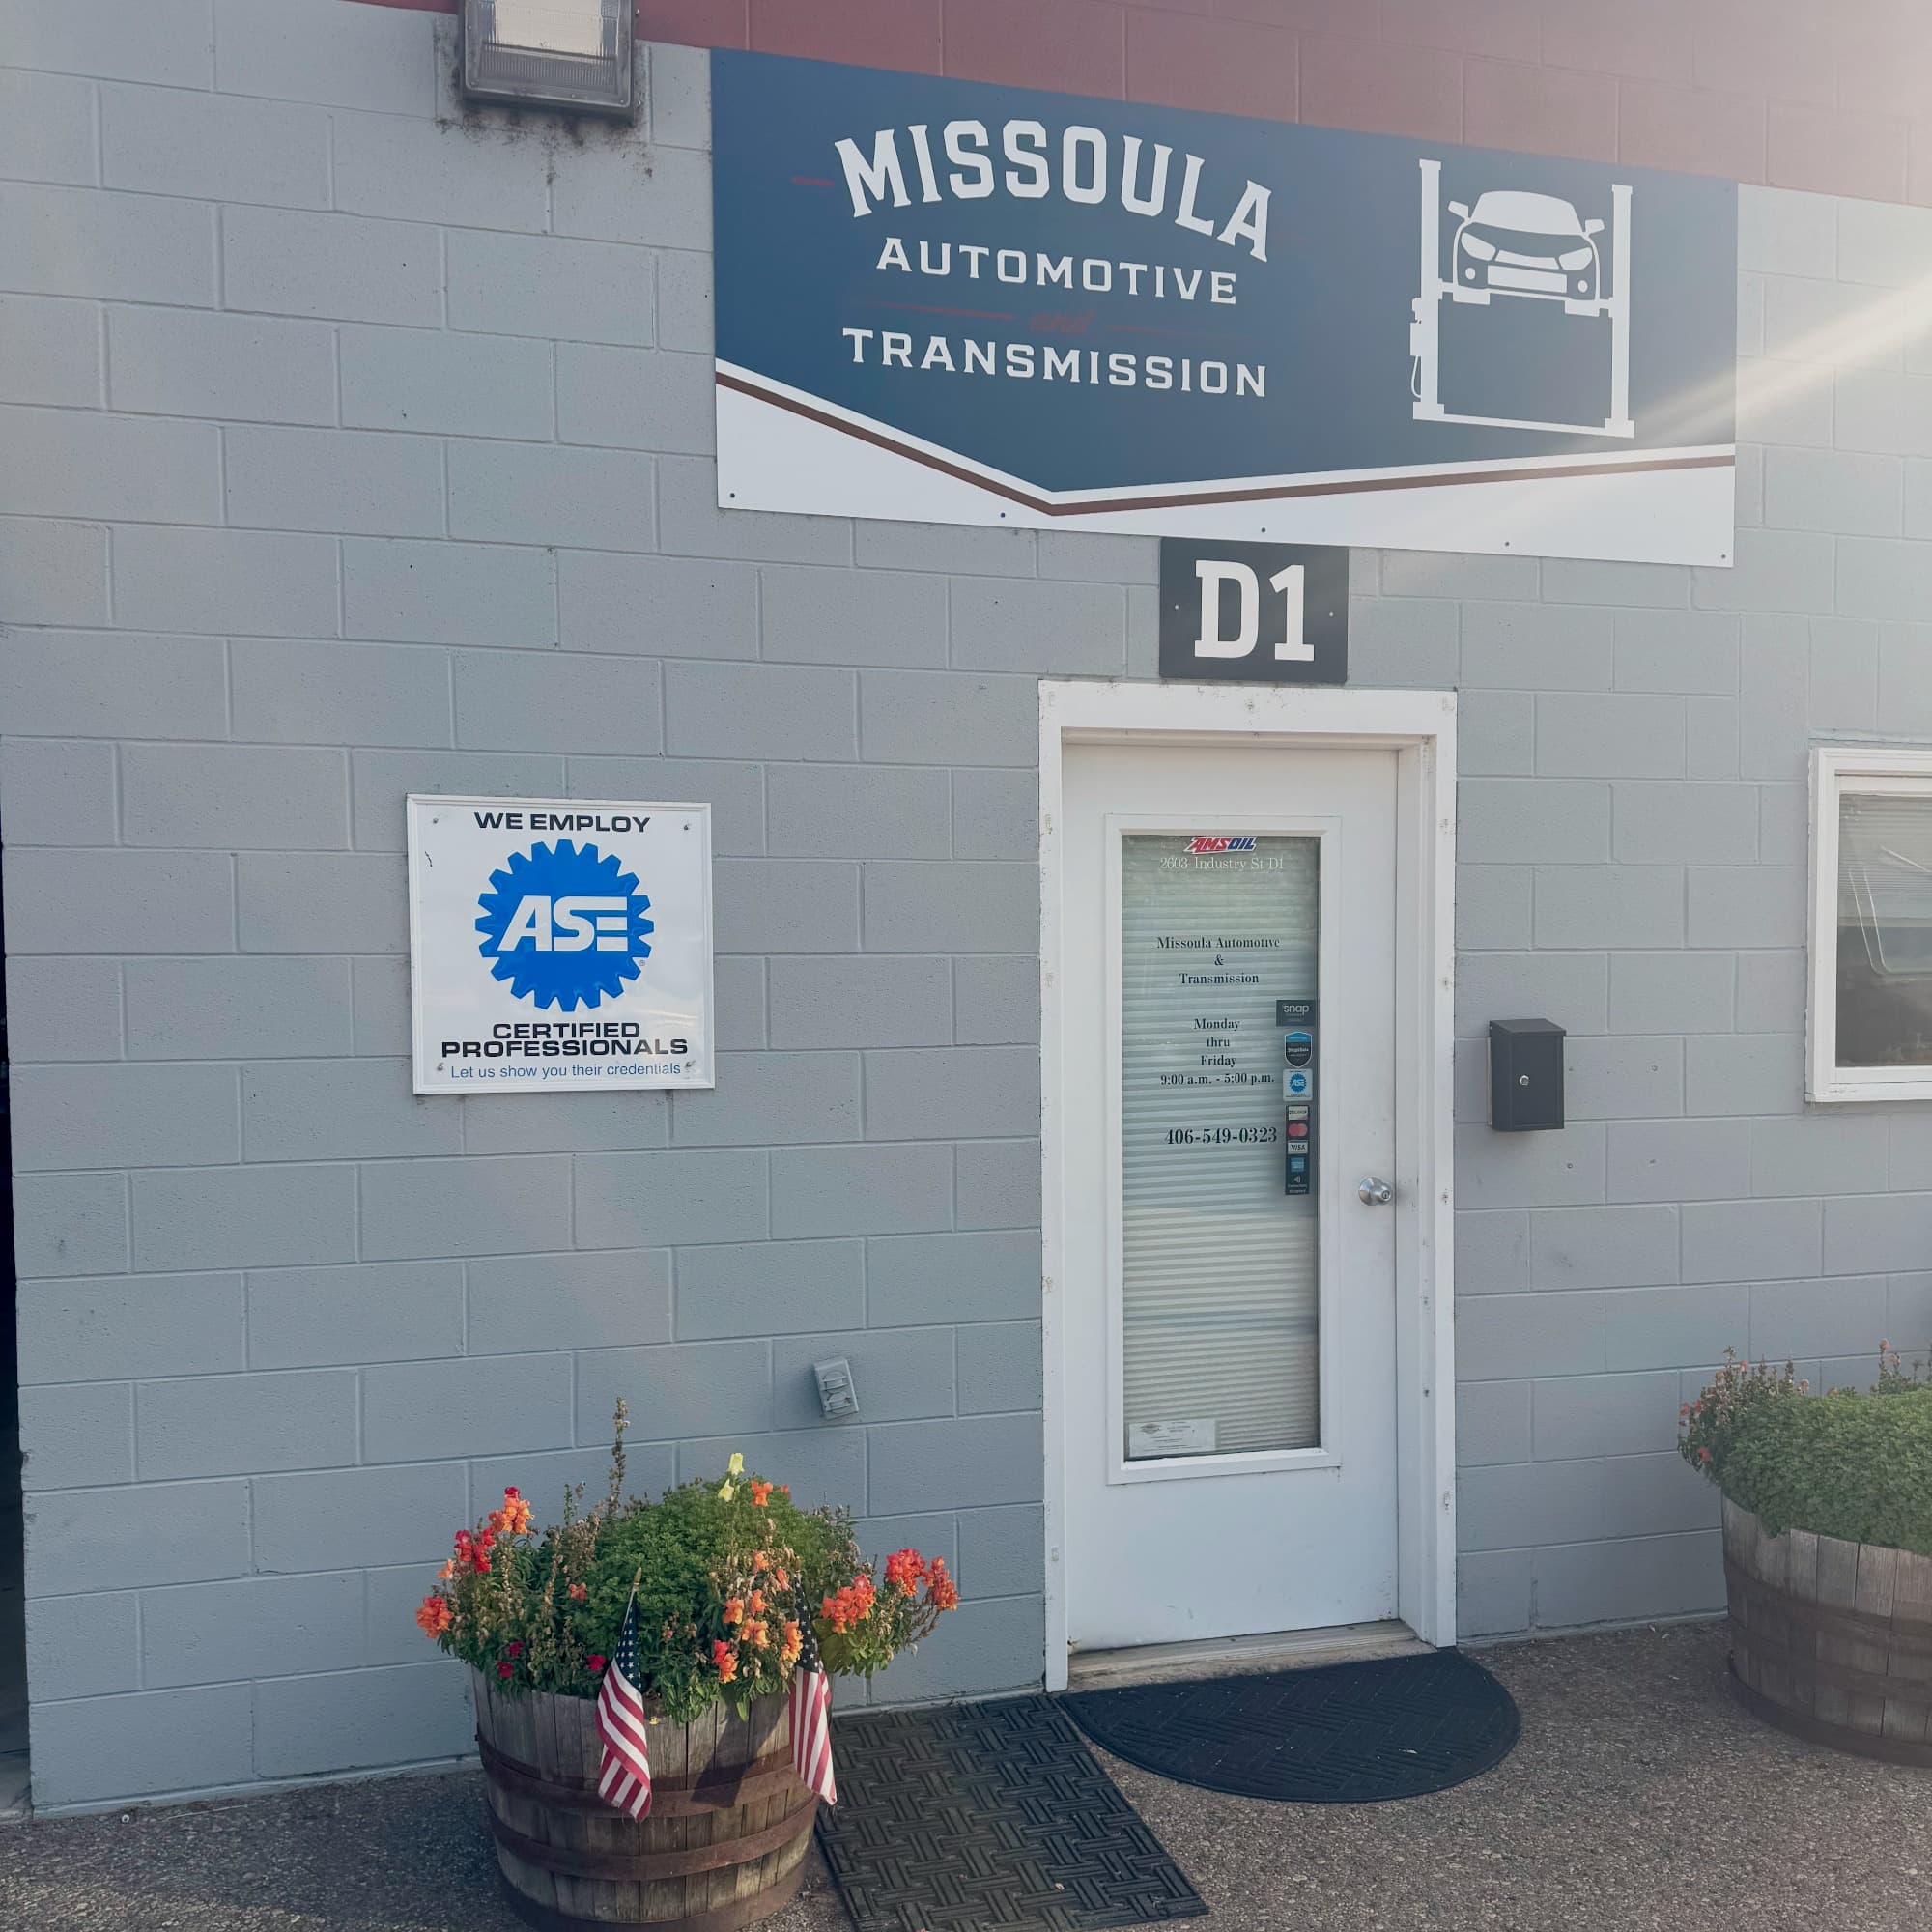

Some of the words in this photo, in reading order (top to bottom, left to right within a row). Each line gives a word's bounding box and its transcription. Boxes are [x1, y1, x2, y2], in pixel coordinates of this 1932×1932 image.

[834, 119, 1272, 263] MISSOULA
[875, 237, 1236, 305] AUTOMOTIVE
[1028, 309, 1095, 335] and
[842, 327, 1266, 398] TRANSMISSION
[1194, 559, 1315, 662] D1
[474, 812, 523, 830] WE
[530, 813, 651, 833] EMPLOY
[1185, 836, 1256, 854] AMSOIL
[1160, 857, 1188, 869] 2603
[1195, 857, 1246, 870] Industry
[1251, 857, 1264, 869] St
[1268, 857, 1284, 869] D1
[497, 895, 628, 952] ASE
[1156, 936, 1211, 949] Missoula
[1215, 936, 1280, 949] Automotive
[1214, 954, 1224, 966] &
[1179, 973, 1260, 984] Transmission
[1283, 1005, 1310, 1015] snap
[493, 1022, 640, 1039] CERTIFIED
[1194, 1018, 1240, 1031] Monday
[441, 1038, 688, 1058] PROFESSIONALS
[1207, 1037, 1230, 1047] thru
[1201, 1055, 1236, 1067] Friday
[451, 1065, 473, 1078] Let
[478, 1067, 495, 1078] us
[499, 1064, 537, 1078] show
[542, 1066, 567, 1080] you
[572, 1063, 602, 1076] their
[607, 1062, 681, 1076] credentials
[1160, 1074, 1184, 1085] 9:00
[1187, 1075, 1212, 1085] a.m.
[1224, 1073, 1247, 1084] 5:00
[1251, 1074, 1275, 1086] p.m.
[1164, 1126, 1278, 1145] 406-549-0323
